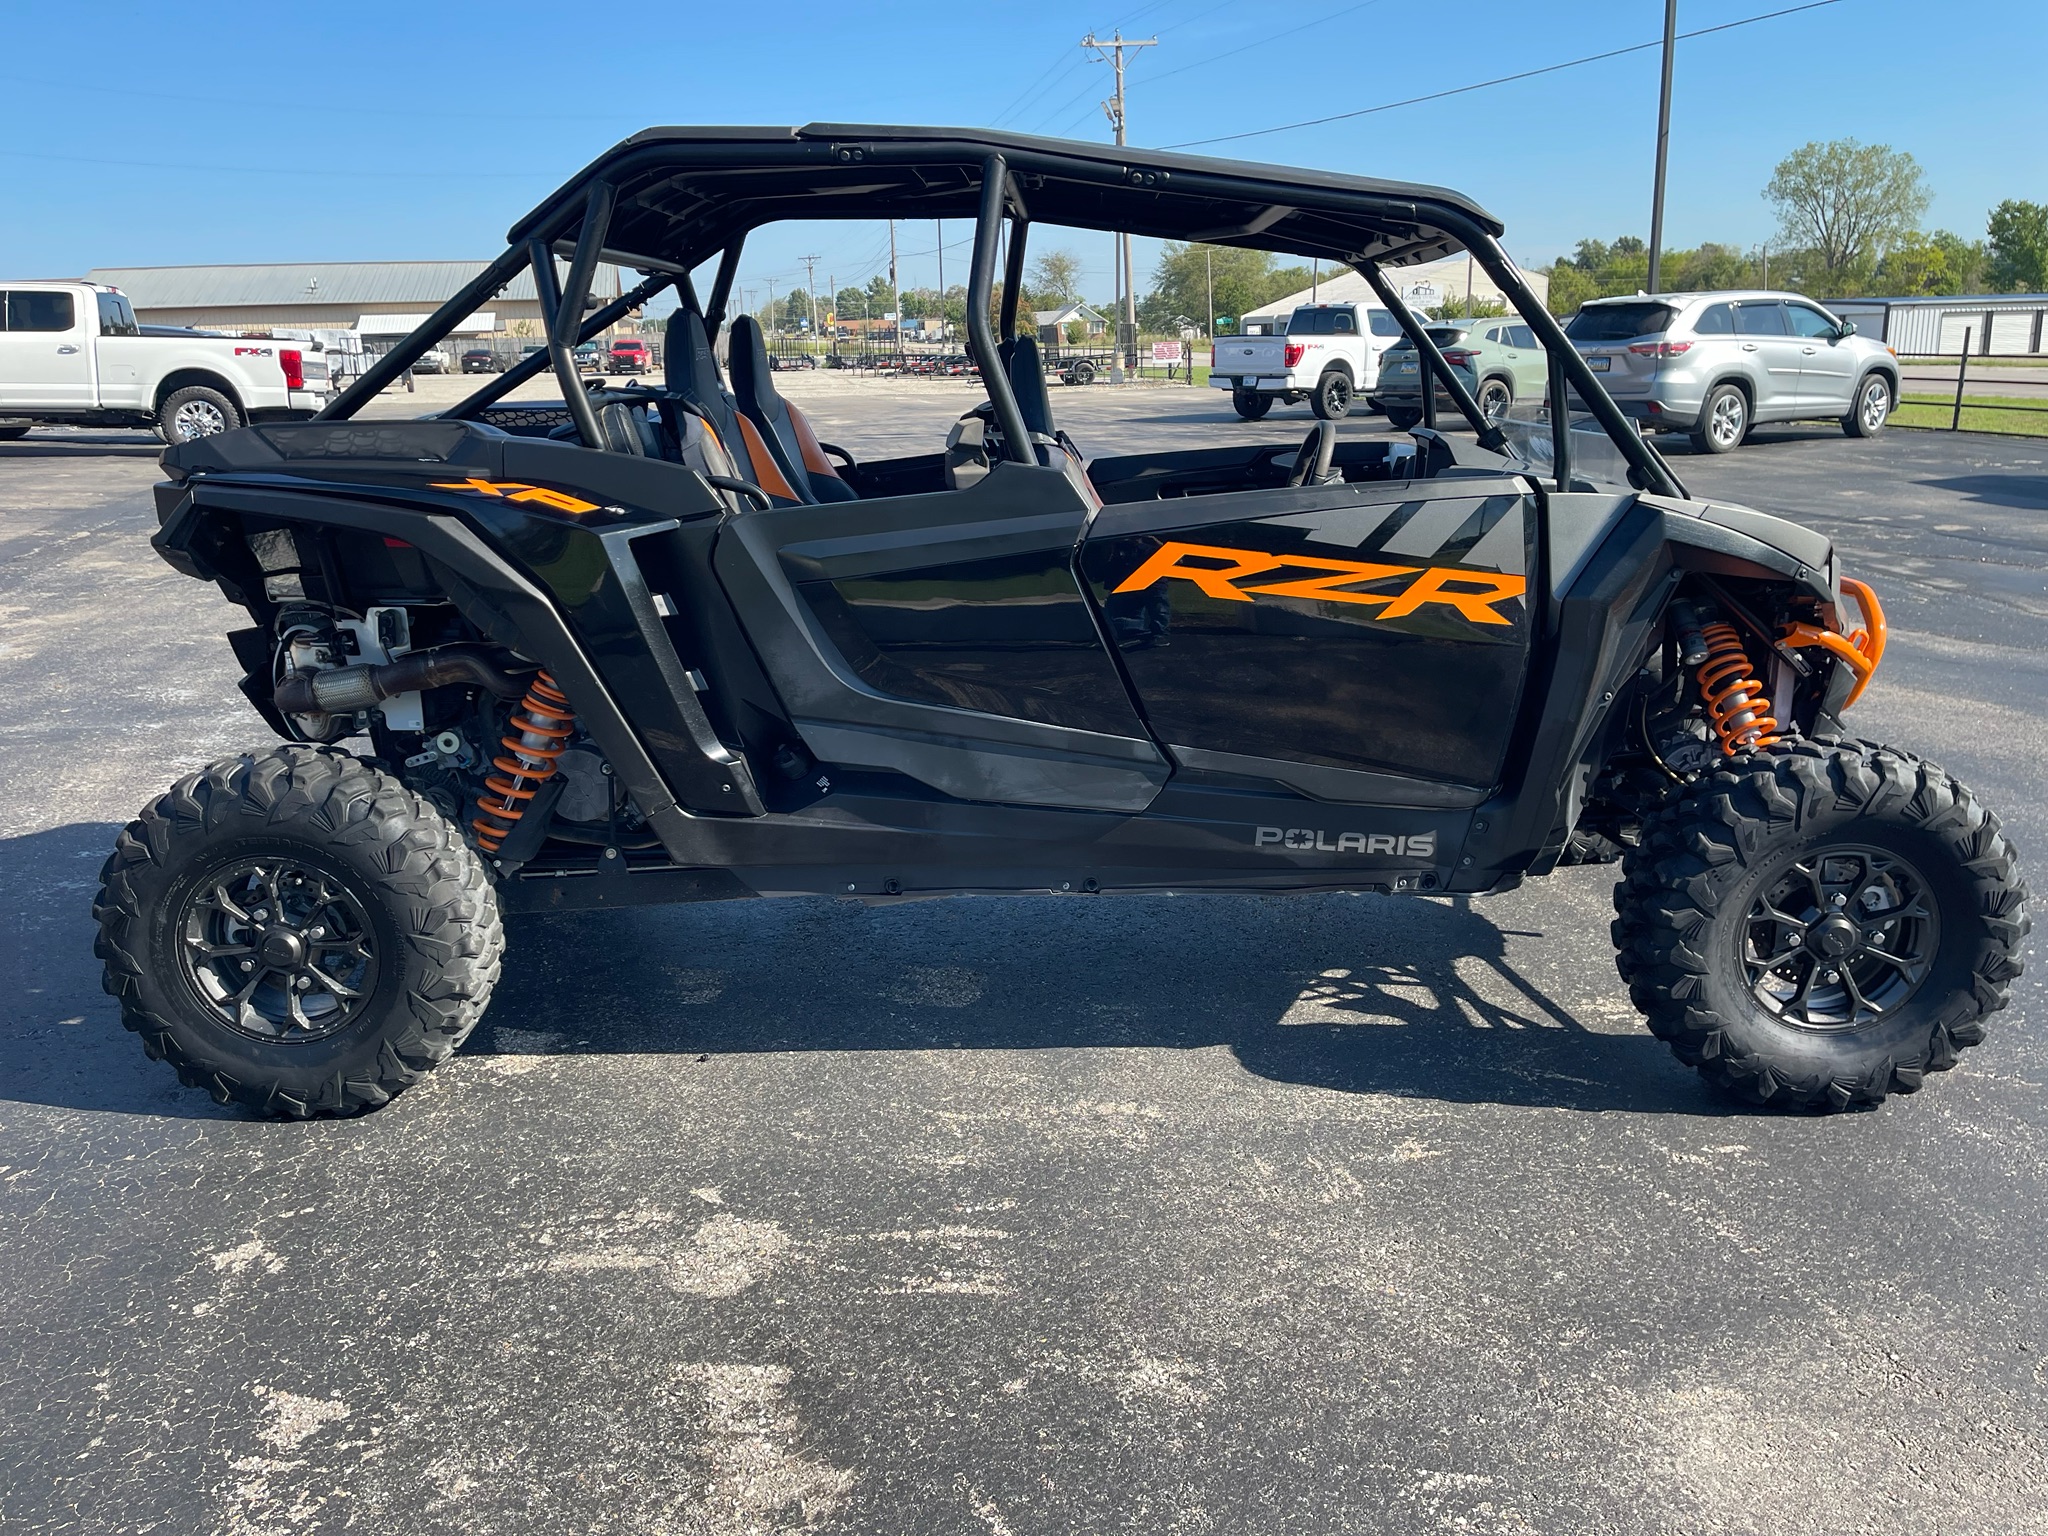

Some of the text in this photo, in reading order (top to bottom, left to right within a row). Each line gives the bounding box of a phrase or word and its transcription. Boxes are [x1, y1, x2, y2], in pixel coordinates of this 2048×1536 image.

[234, 347, 273, 357] FX4
[426, 478, 602, 514] XP
[1112, 541, 1527, 626] RZR
[1254, 826, 1435, 857] POLARIS
